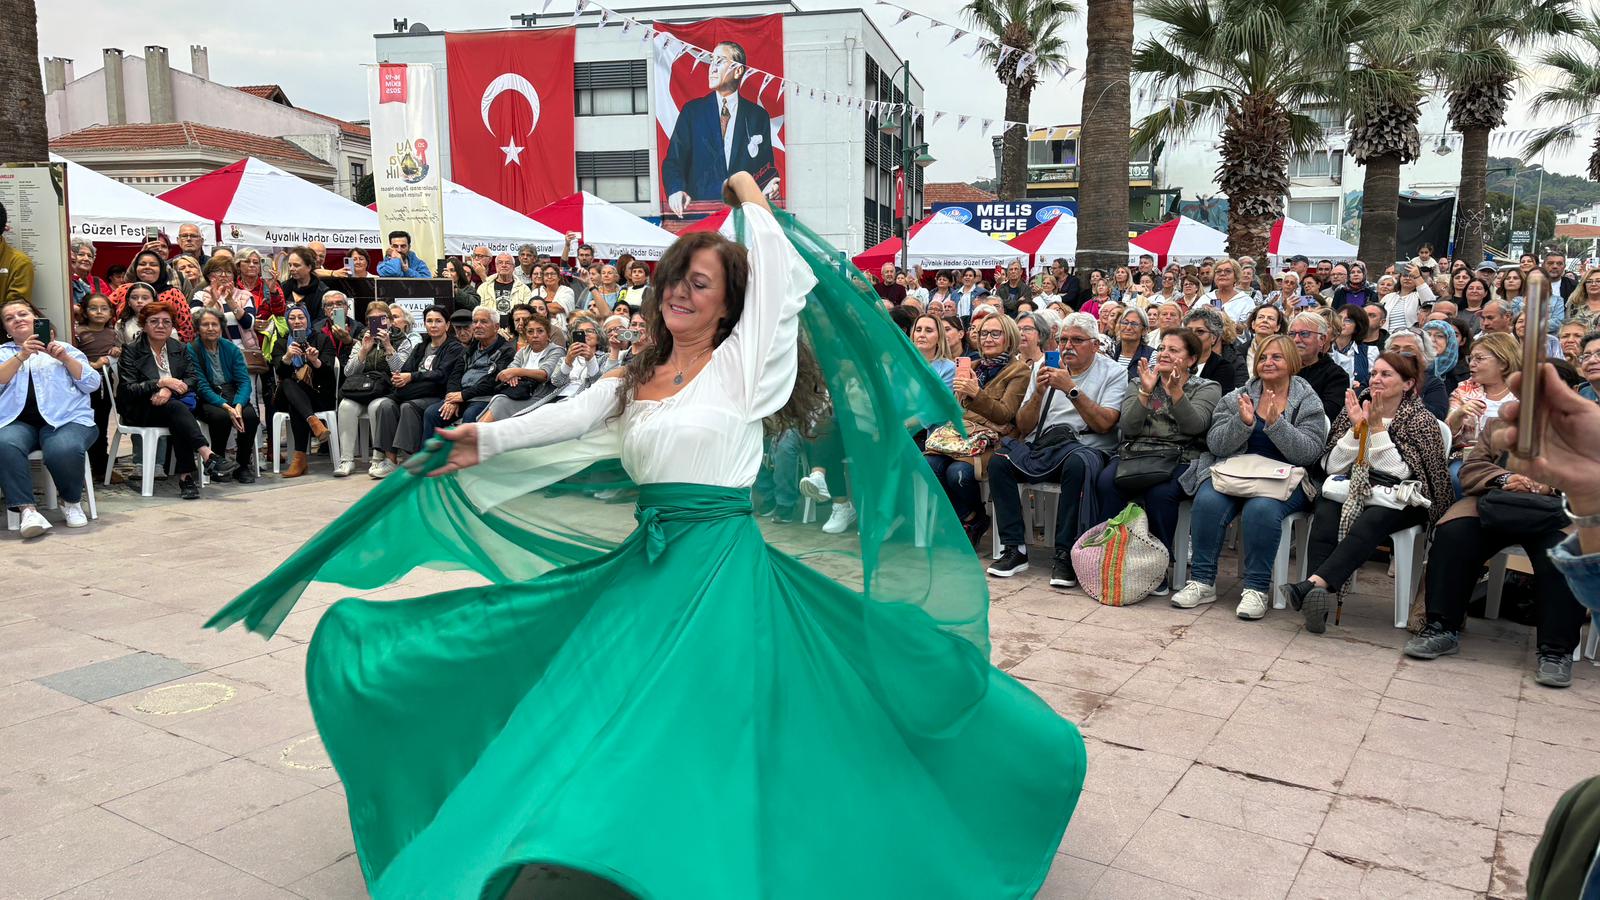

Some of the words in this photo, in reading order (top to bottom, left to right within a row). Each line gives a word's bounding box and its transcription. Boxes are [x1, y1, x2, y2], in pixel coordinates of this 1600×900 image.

[82, 223, 116, 235] Güzel
[980, 218, 1027, 230] BÜFE
[265, 231, 300, 243] Ayvalık
[332, 233, 357, 243] Güzel
